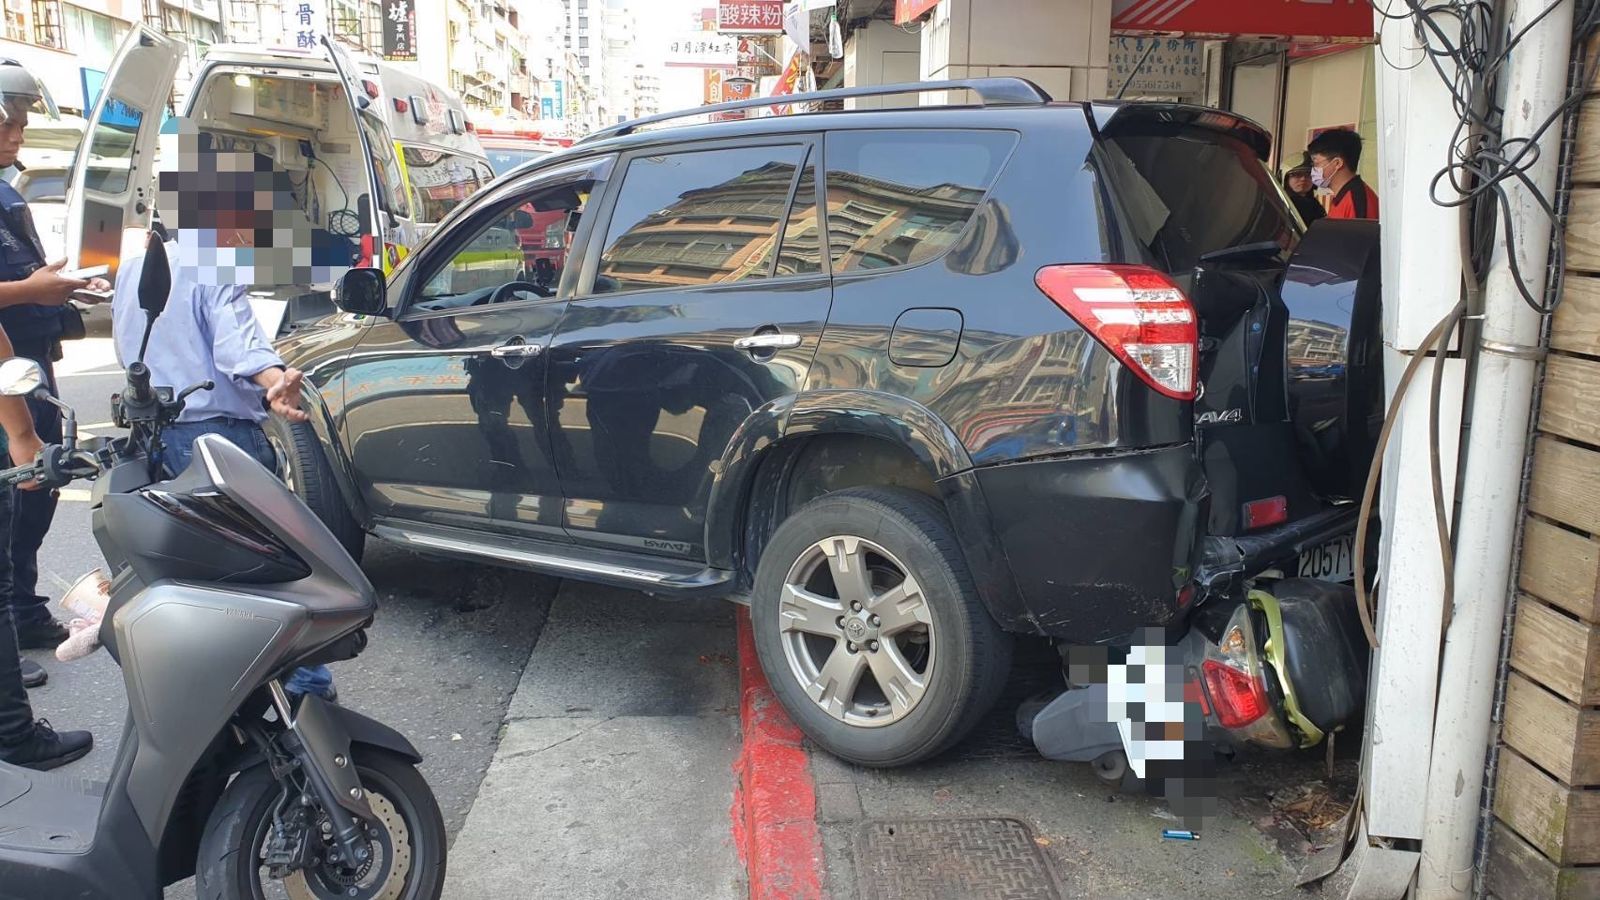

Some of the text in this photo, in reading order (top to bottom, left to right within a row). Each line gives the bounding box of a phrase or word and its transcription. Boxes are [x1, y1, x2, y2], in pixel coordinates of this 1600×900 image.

[296, 3, 317, 49] 骨酥
[719, 3, 783, 26] 酸辣粉
[1194, 408, 1242, 424] AV4
